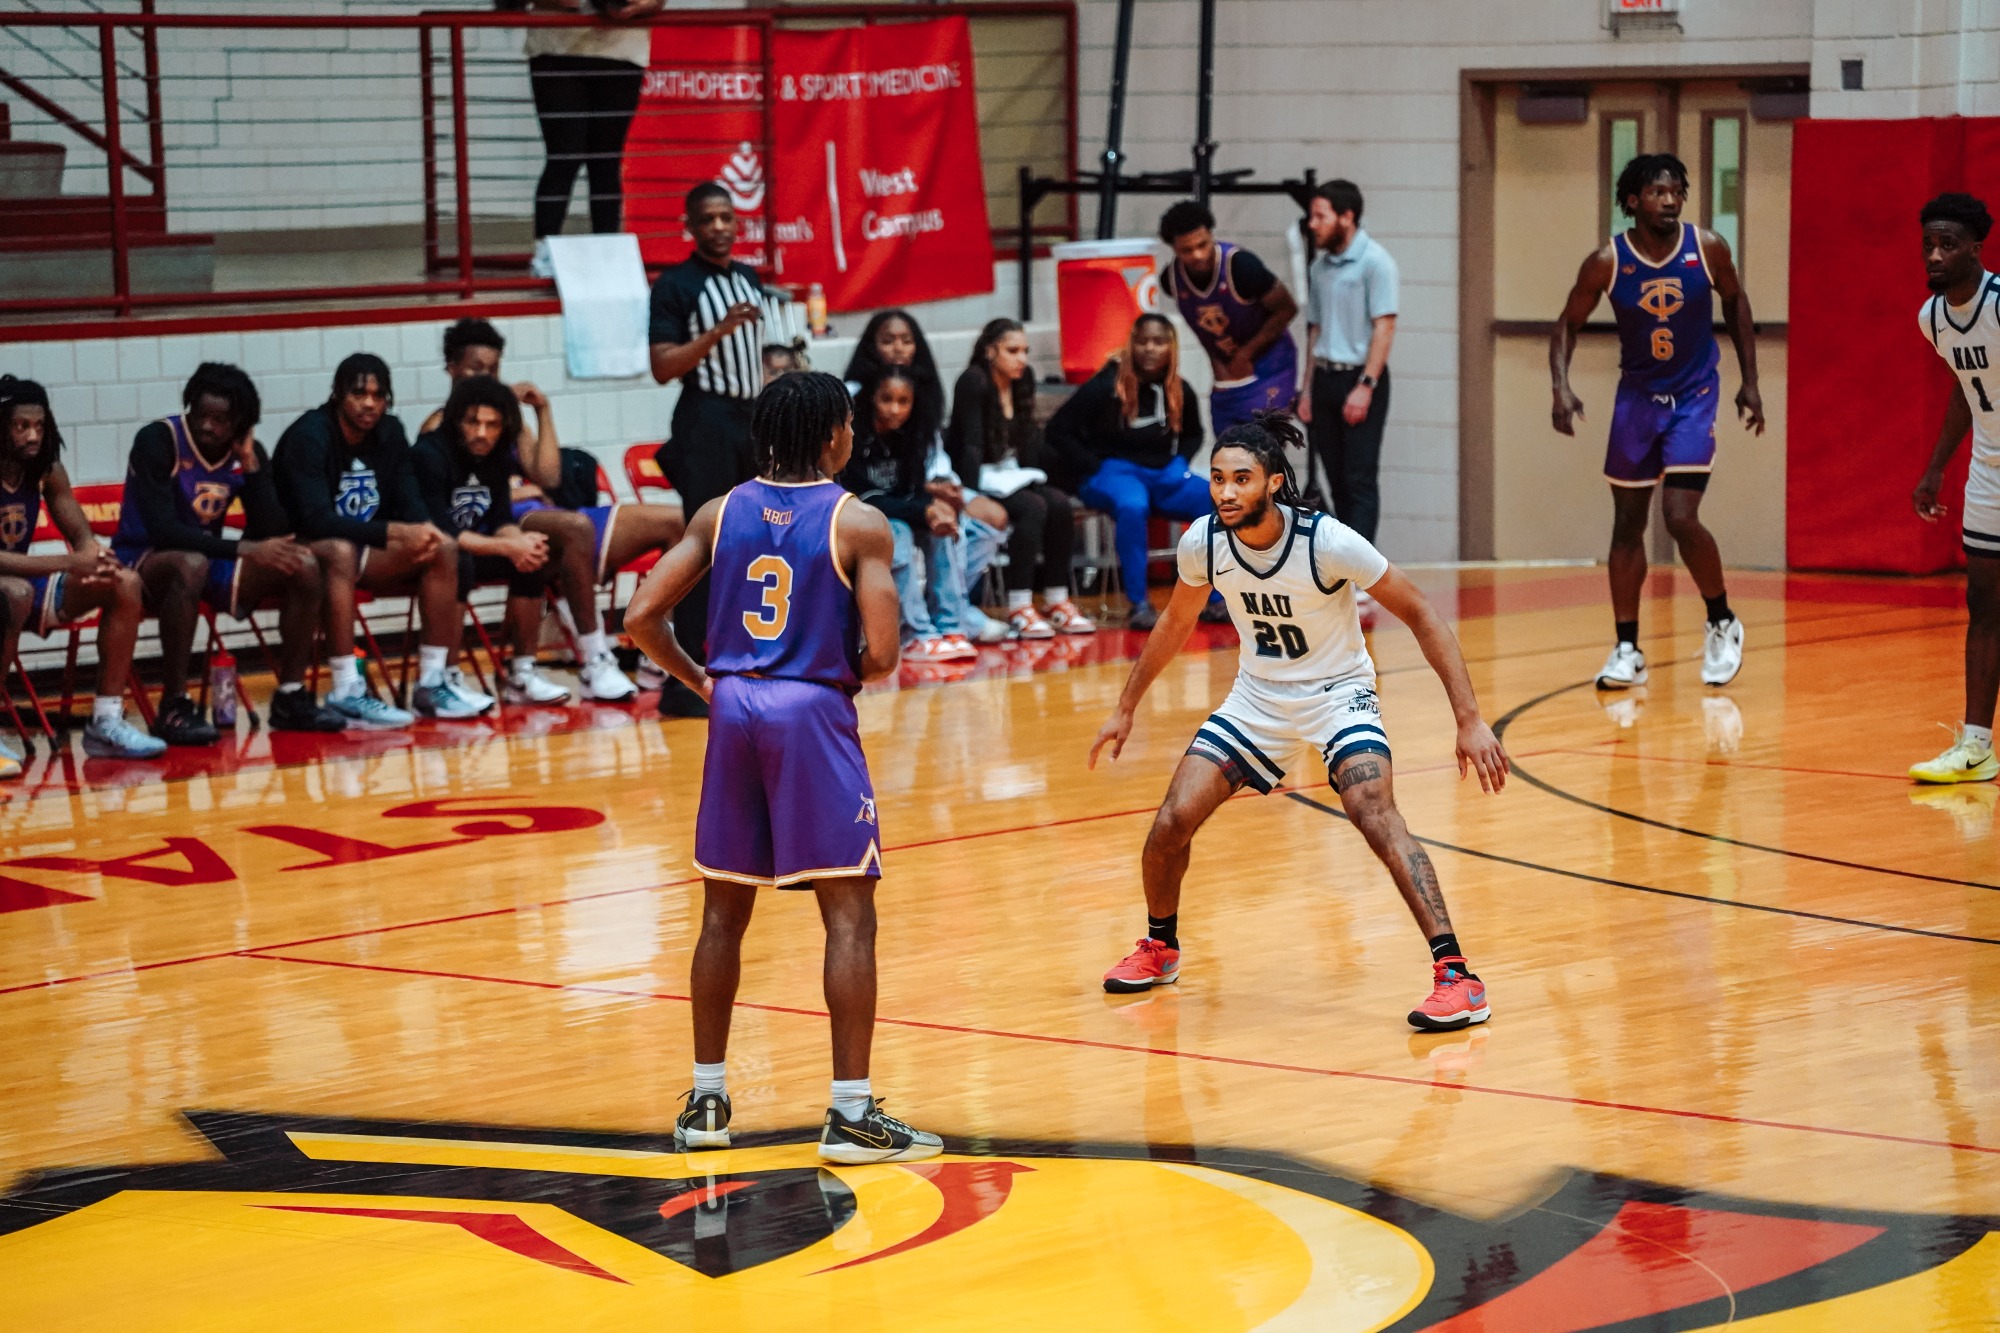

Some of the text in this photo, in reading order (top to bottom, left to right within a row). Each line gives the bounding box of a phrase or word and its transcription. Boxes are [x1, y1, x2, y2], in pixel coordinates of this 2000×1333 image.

[780, 74, 797, 101] &
[859, 168, 918, 197] West
[1650, 328, 1674, 361] 6
[1953, 346, 1989, 370] NAU
[1971, 376, 1994, 412] 1
[762, 506, 793, 526] HBCU
[743, 554, 793, 640] 3
[1240, 591, 1293, 618] NAU
[1252, 619, 1309, 660] 20
